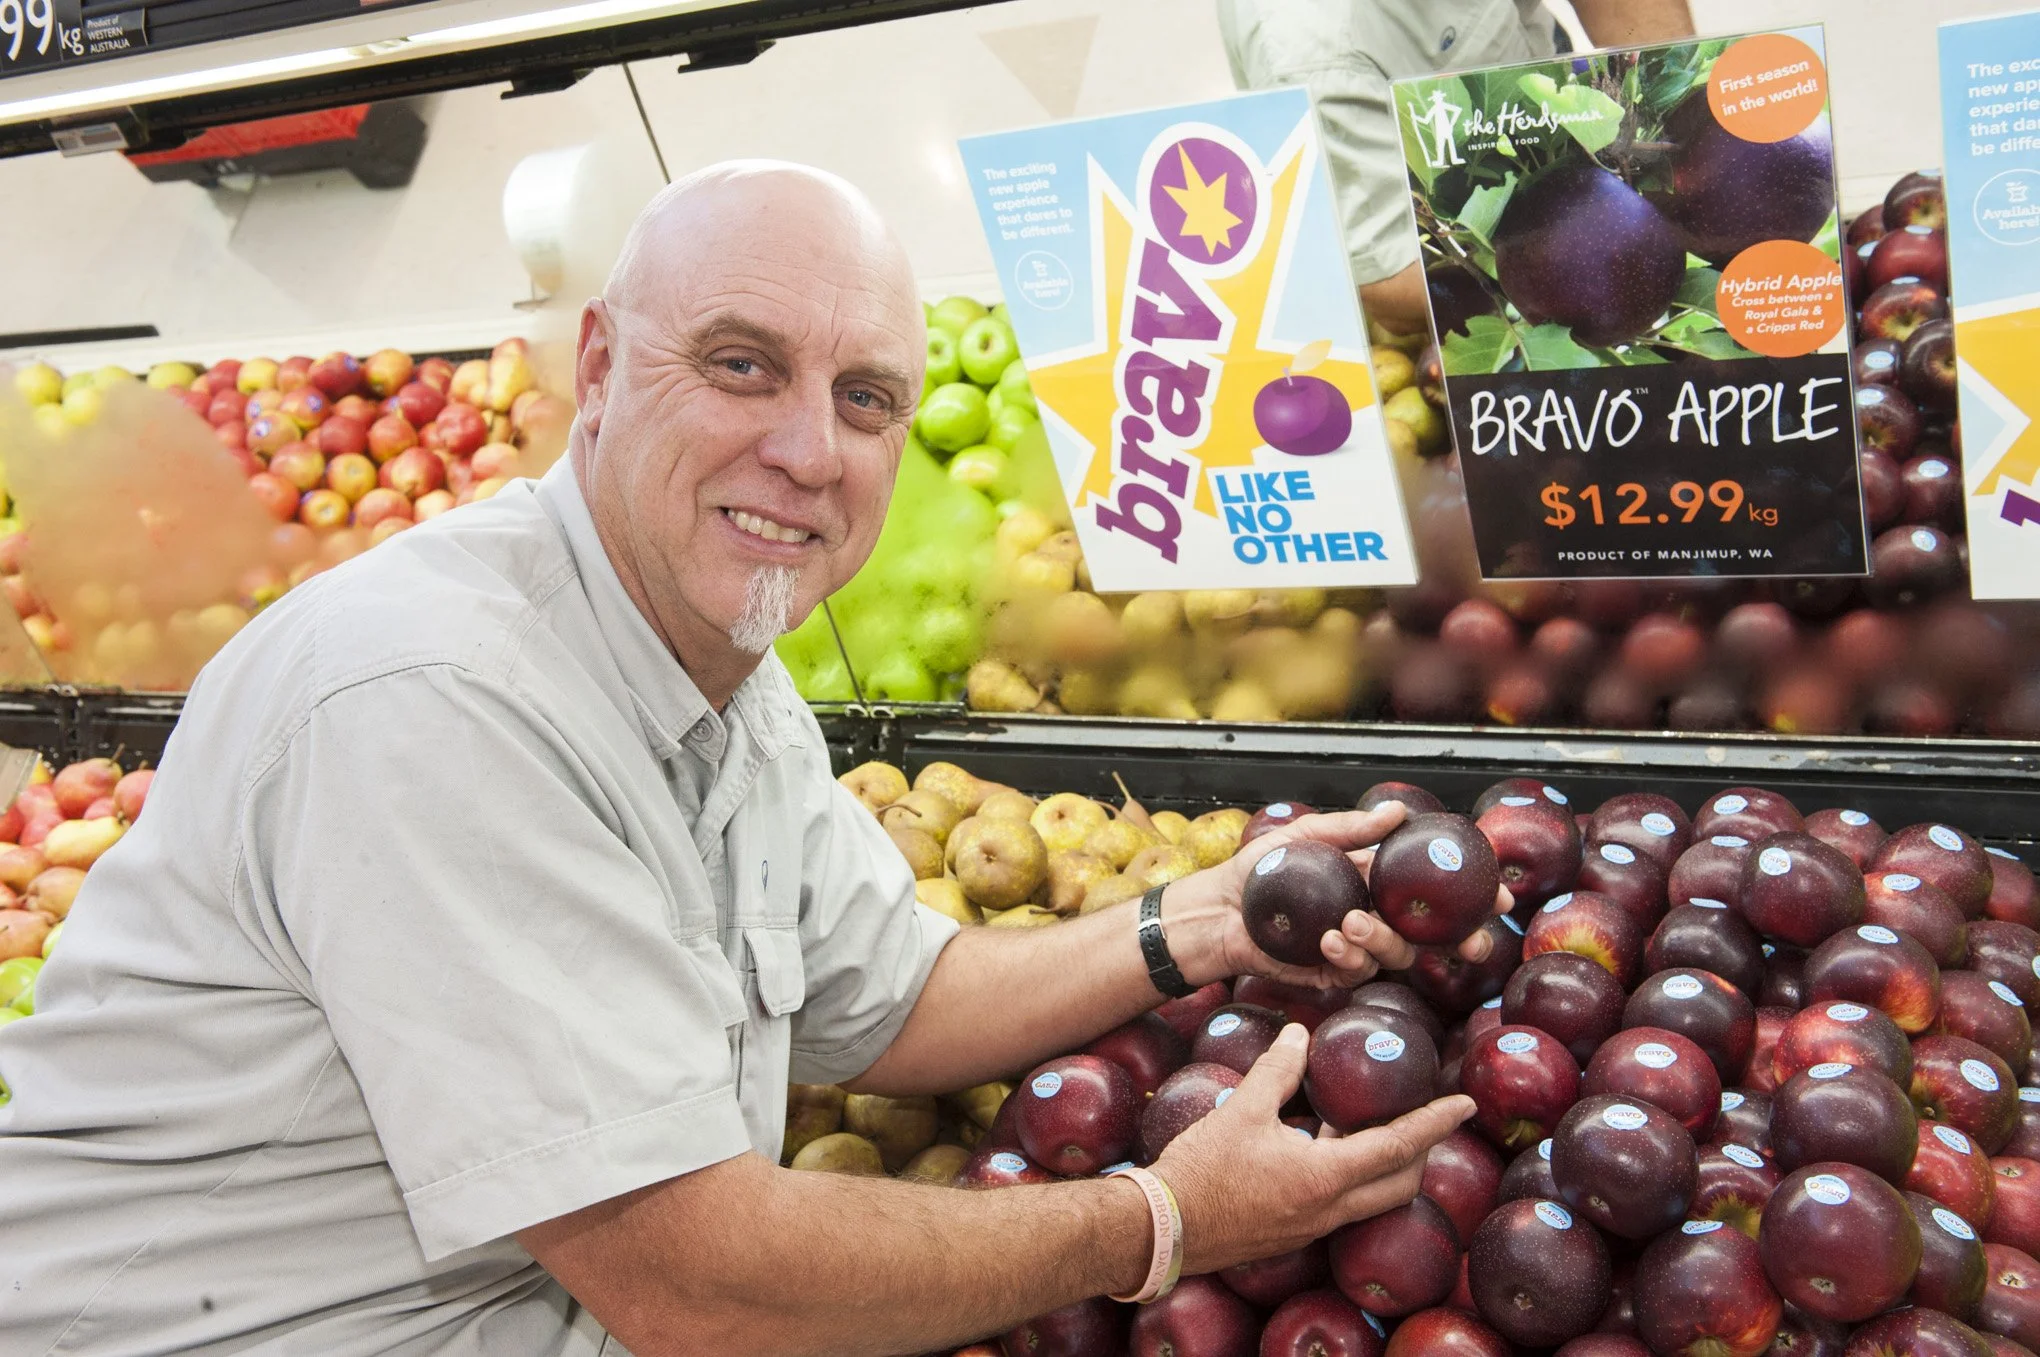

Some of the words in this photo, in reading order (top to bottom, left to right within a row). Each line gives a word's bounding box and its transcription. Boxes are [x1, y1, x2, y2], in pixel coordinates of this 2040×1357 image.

[58, 22, 84, 55] kg
[87, 27, 123, 40] WESTERN
[90, 38, 130, 53] AUSTRALIA
[1719, 74, 1754, 94] First
[1756, 60, 1810, 84] season
[1967, 62, 2004, 78] The
[1722, 103, 1738, 116] in
[1739, 96, 1766, 111] the
[1768, 78, 1819, 103] world!
[1968, 83, 2008, 98] new
[1463, 108, 1495, 136] the
[1969, 120, 2008, 137] that
[1515, 136, 1540, 146] FOOD
[1971, 142, 1995, 156] be
[982, 168, 1007, 180] The
[1009, 162, 1057, 175] exciting
[988, 184, 1014, 196] new
[1017, 179, 1050, 193] apple
[993, 194, 1059, 211] experience
[997, 213, 1023, 225] that
[1024, 210, 1058, 223] dares
[1059, 208, 1073, 219] to
[1001, 230, 1018, 240] be
[1020, 223, 1075, 239] different.
[1720, 274, 1783, 297] Hybrid
[1786, 271, 1843, 291] Apple
[1732, 297, 1765, 307] Cross
[1767, 293, 1822, 304] between
[1744, 308, 1779, 322] Royal
[1781, 306, 1809, 317] Gala
[1812, 305, 1822, 315] &
[1756, 323, 1796, 335] Cripps
[1800, 319, 1825, 330] Red
[1667, 377, 1843, 447] APPLE
[1215, 470, 1315, 505] LIKE
[1540, 479, 1745, 531] $12.99
[1749, 503, 1779, 526] kg
[1223, 503, 1292, 535] NO
[1233, 531, 1389, 565] OTHER
[1558, 550, 1625, 561] PRODUCT
[1632, 549, 1651, 560] OF
[1658, 549, 1742, 560] MANJIMUP,
[1748, 548, 1773, 558] WA
[1368, 1038, 1399, 1051] bravo
